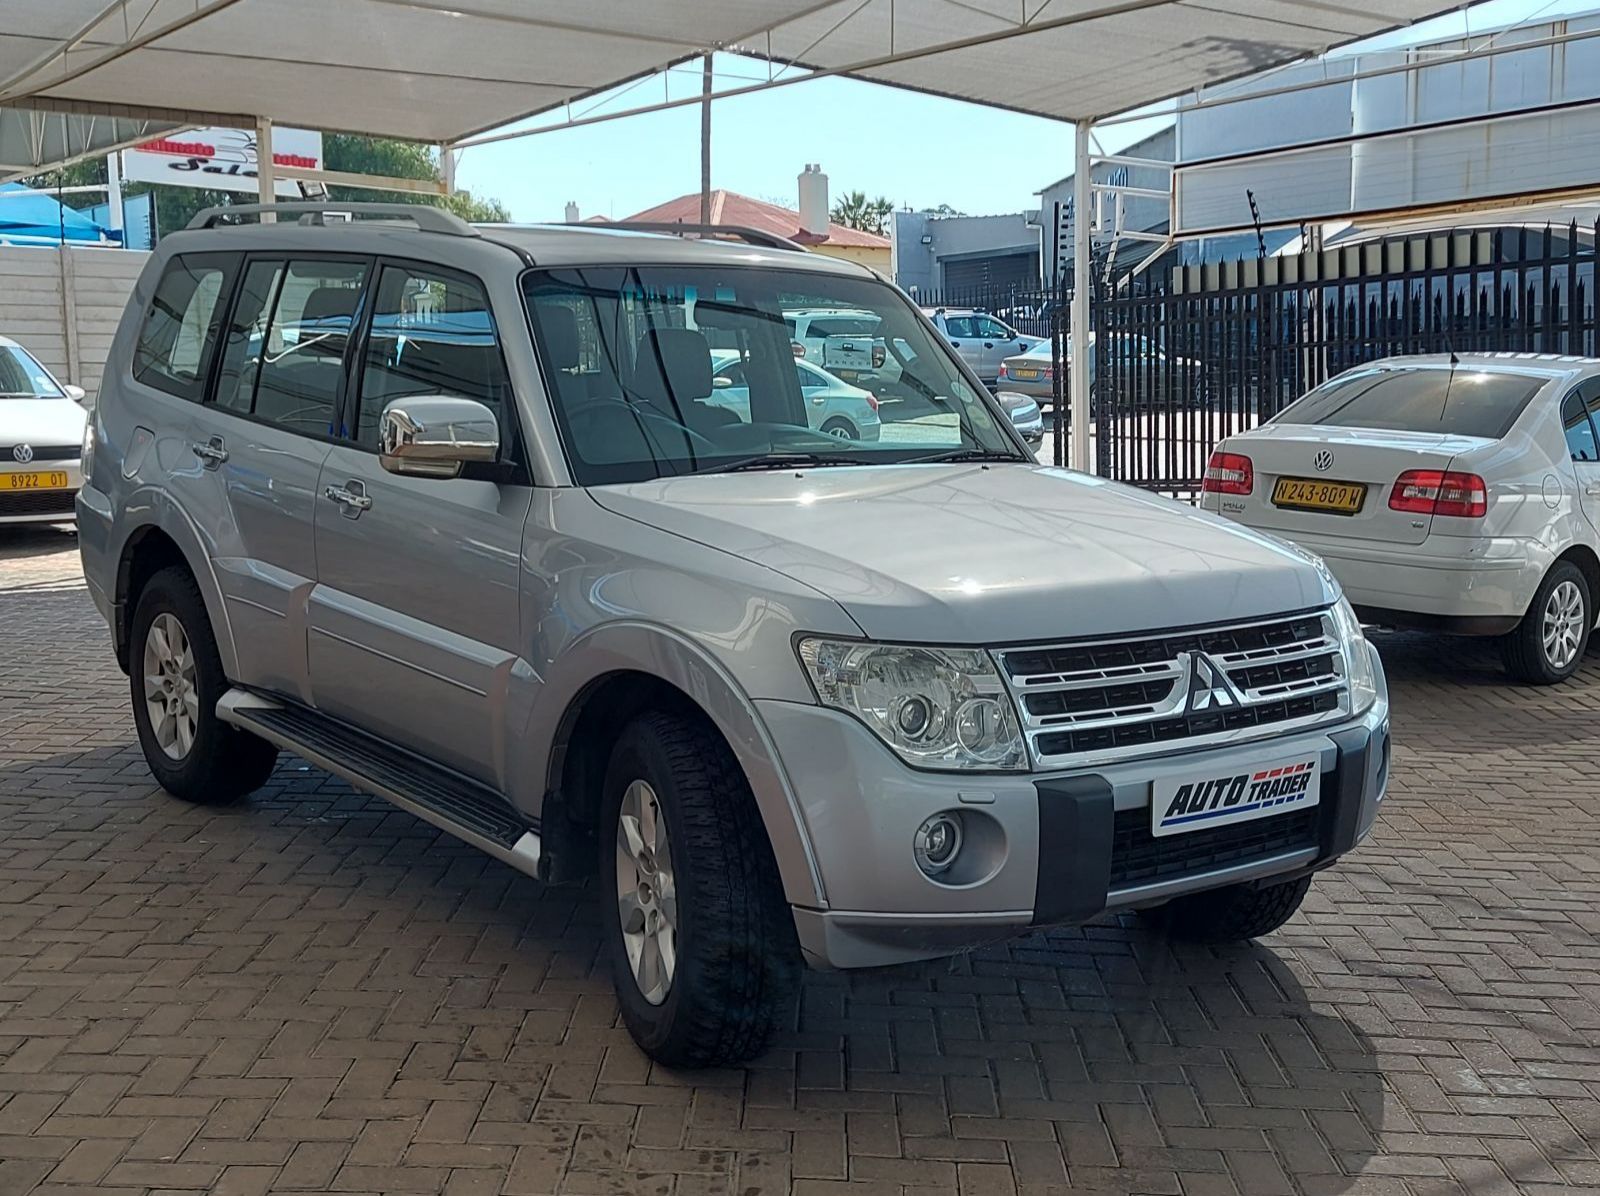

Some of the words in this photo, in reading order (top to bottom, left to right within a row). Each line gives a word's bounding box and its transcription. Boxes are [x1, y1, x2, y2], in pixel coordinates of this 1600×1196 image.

[137, 140, 215, 156] timate
[11, 474, 38, 487] 8922
[1277, 482, 1288, 499] N
[1288, 483, 1347, 504] 243-809
[1349, 489, 1361, 506] W
[1164, 774, 1250, 818] AUTO
[1247, 771, 1312, 803] TRADER
